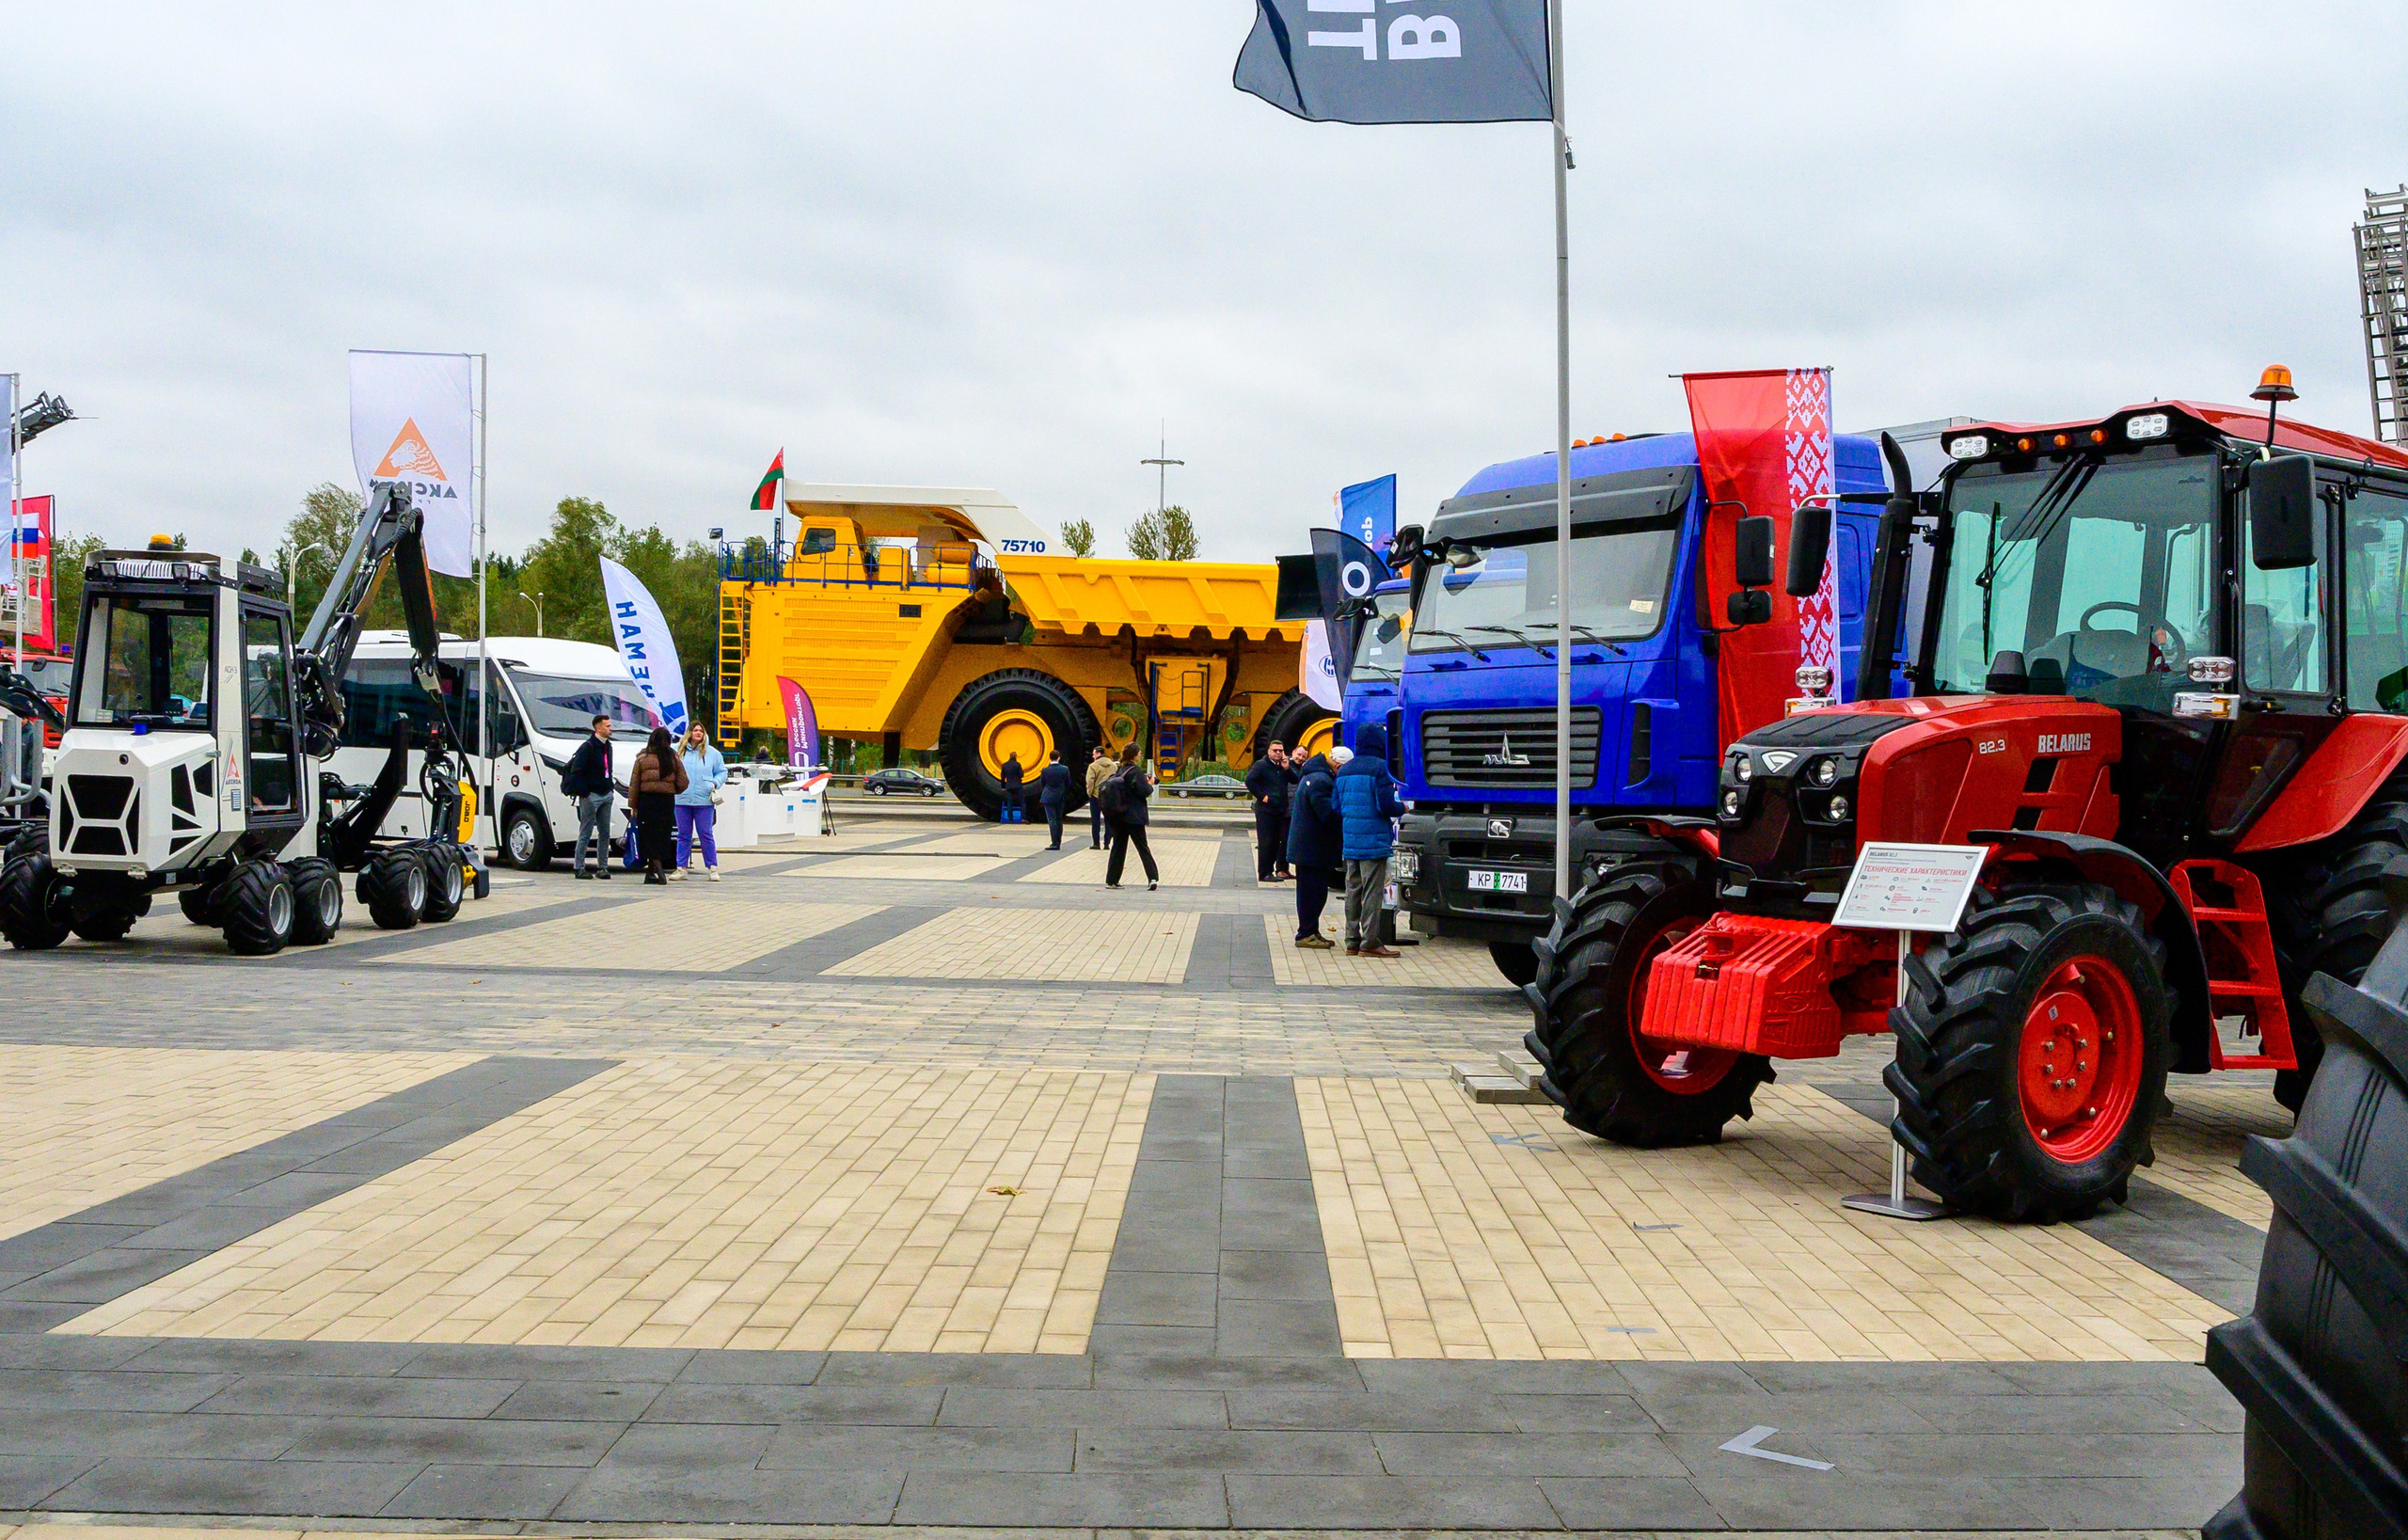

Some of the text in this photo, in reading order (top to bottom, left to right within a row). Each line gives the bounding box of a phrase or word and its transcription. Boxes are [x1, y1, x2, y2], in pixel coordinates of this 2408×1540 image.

[1001, 539, 1046, 553] 75710
[1978, 739, 2005, 754] 82.3
[2037, 733, 2091, 753] BELARUS
[1863, 865, 1968, 877] ТЕХНИЧЕСКИЕ ХАРАКТЕРИСТИКИ
[1501, 874, 1524, 889] 7741
